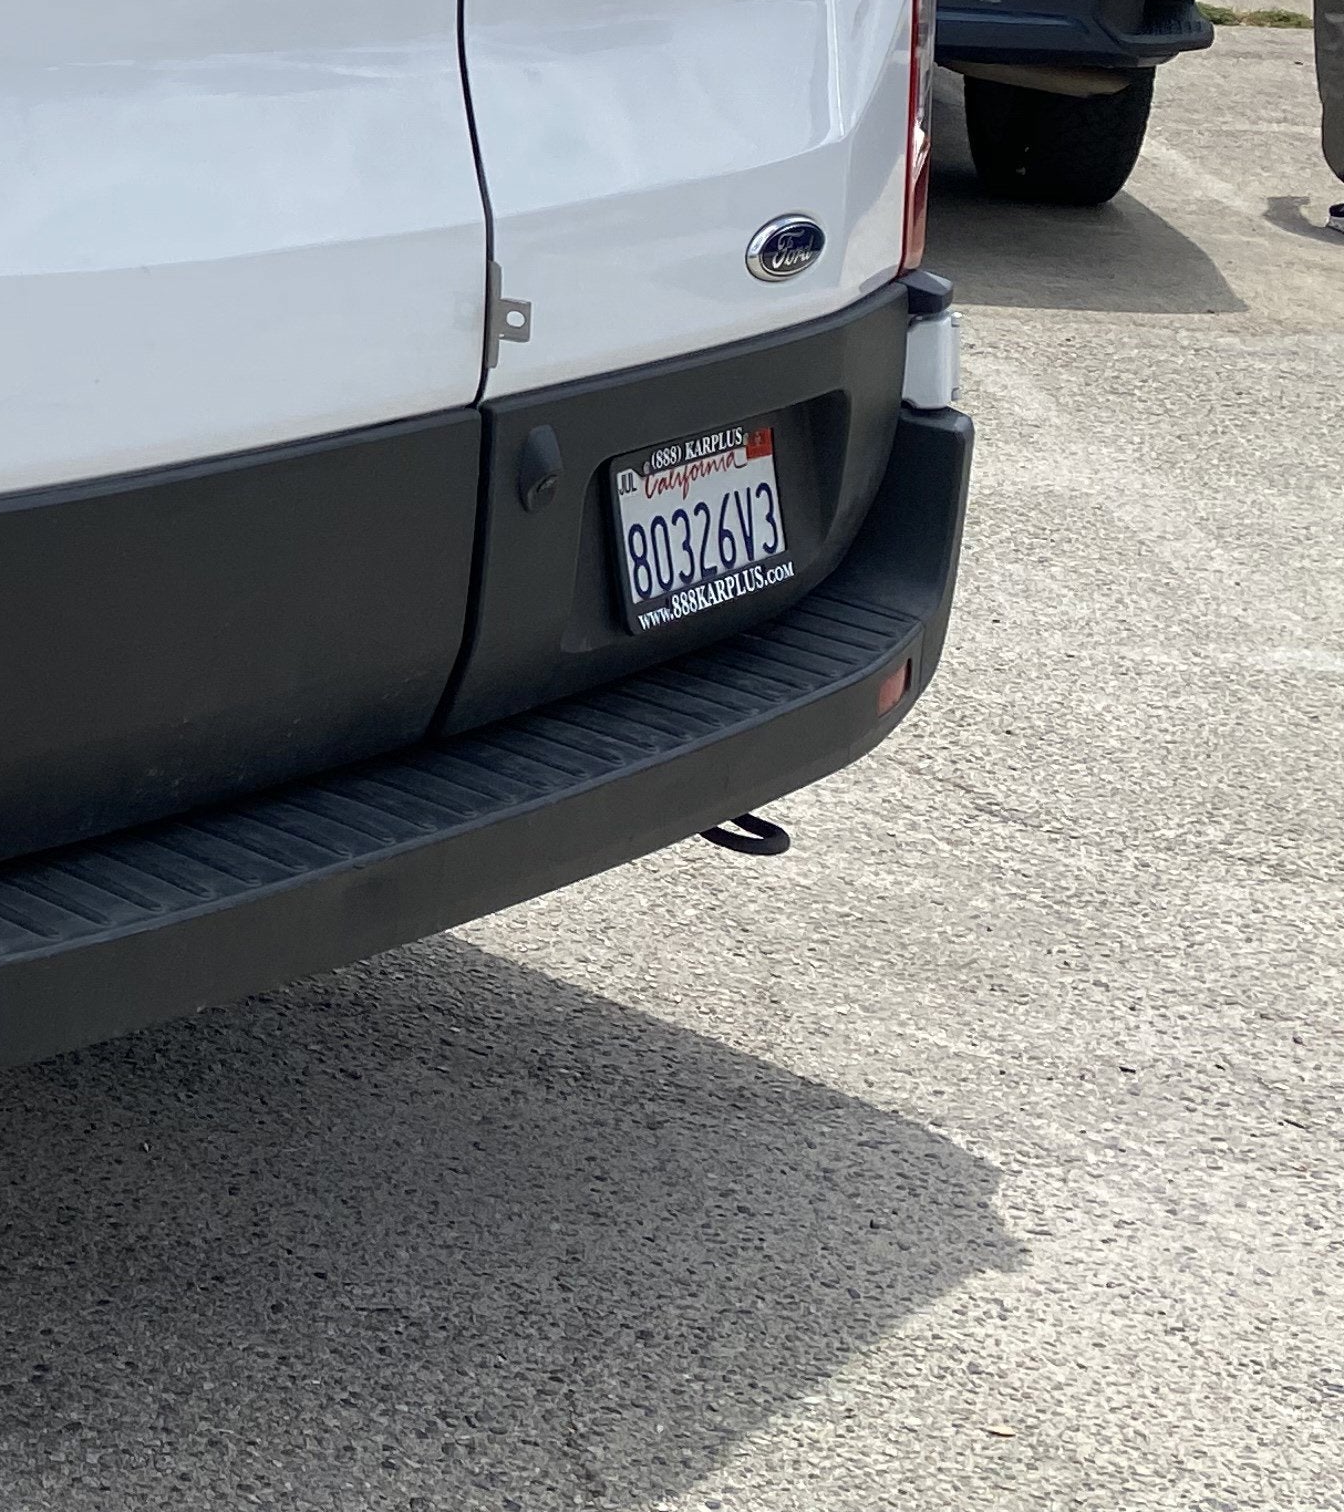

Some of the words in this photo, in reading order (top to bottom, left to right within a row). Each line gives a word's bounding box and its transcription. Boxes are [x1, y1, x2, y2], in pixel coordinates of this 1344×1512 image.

[772, 229, 815, 269] Ford
[650, 444, 683, 470] (888)
[684, 426, 744, 461] KARPLUS
[644, 448, 748, 501] California
[627, 482, 779, 600] 80326V3
